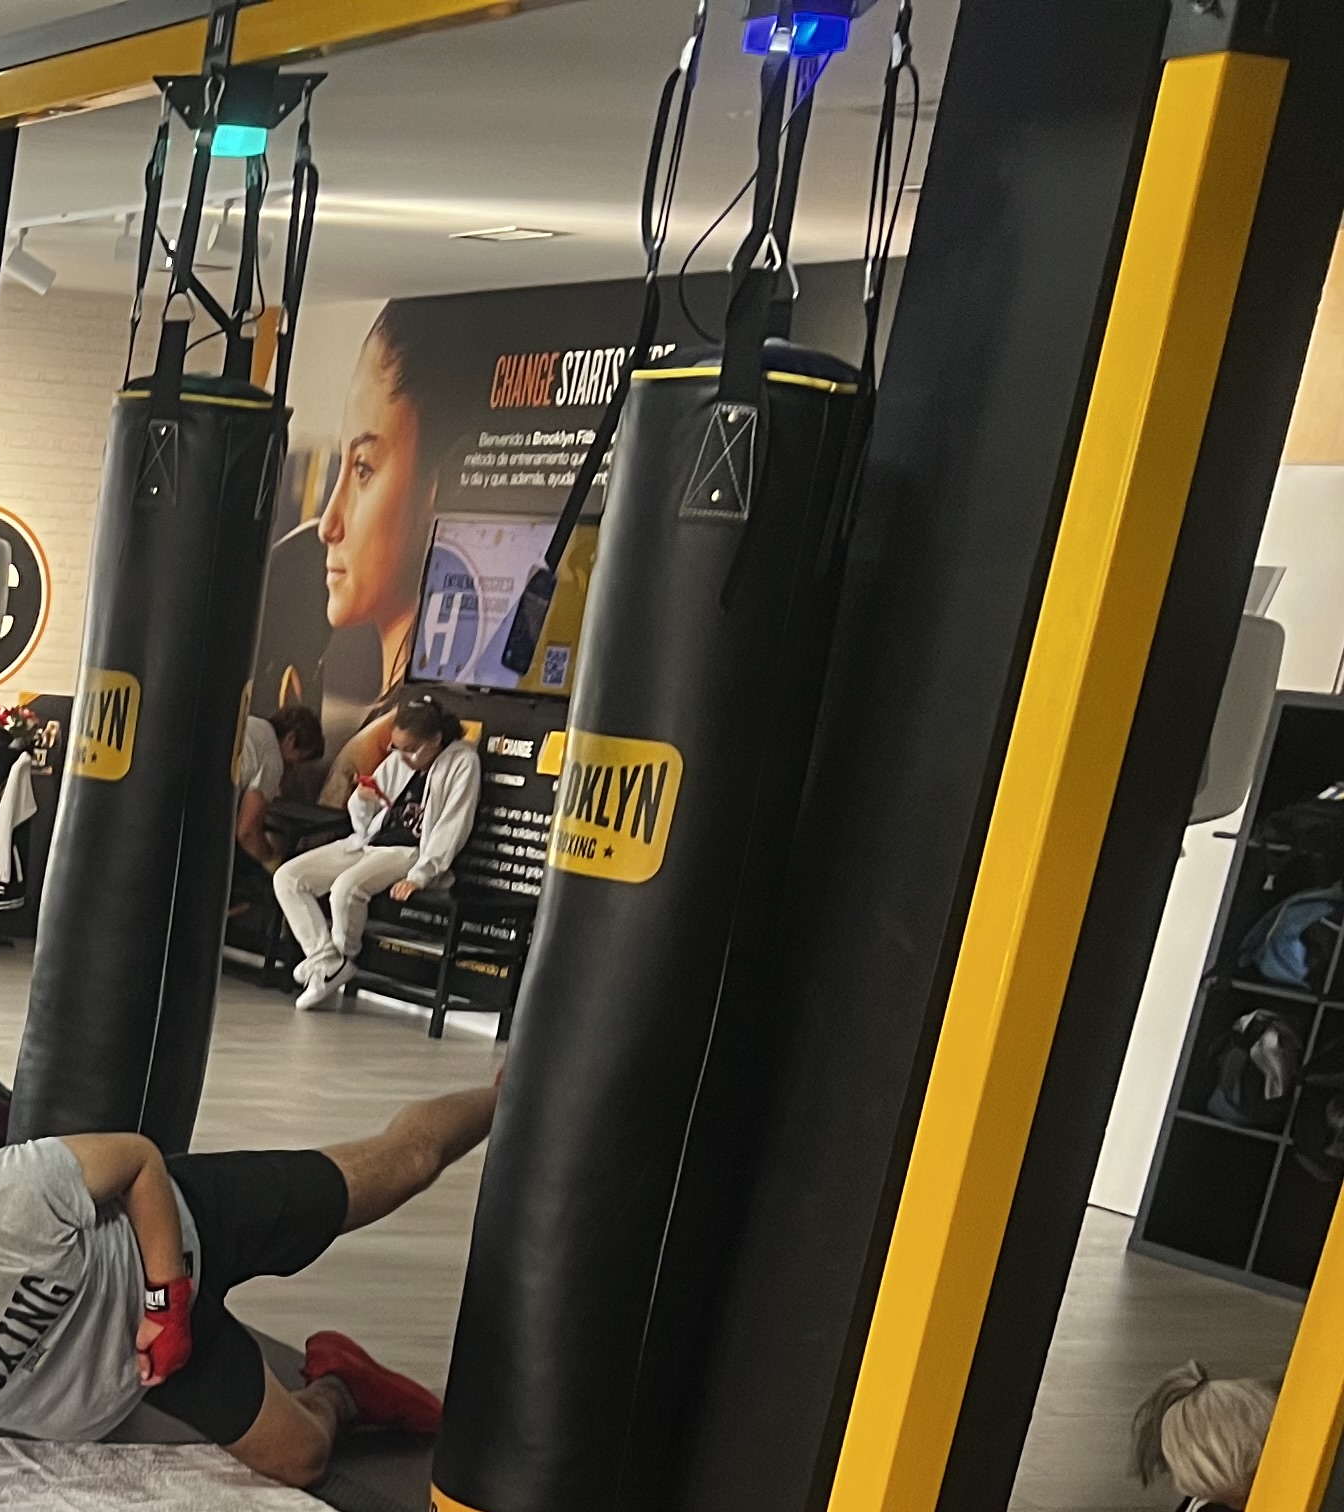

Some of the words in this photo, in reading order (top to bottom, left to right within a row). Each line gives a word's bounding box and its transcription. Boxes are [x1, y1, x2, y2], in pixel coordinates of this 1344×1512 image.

[490, 353, 560, 409] CHANGE
[555, 347, 625, 407] STARTS
[562, 761, 669, 845] OKLYN
